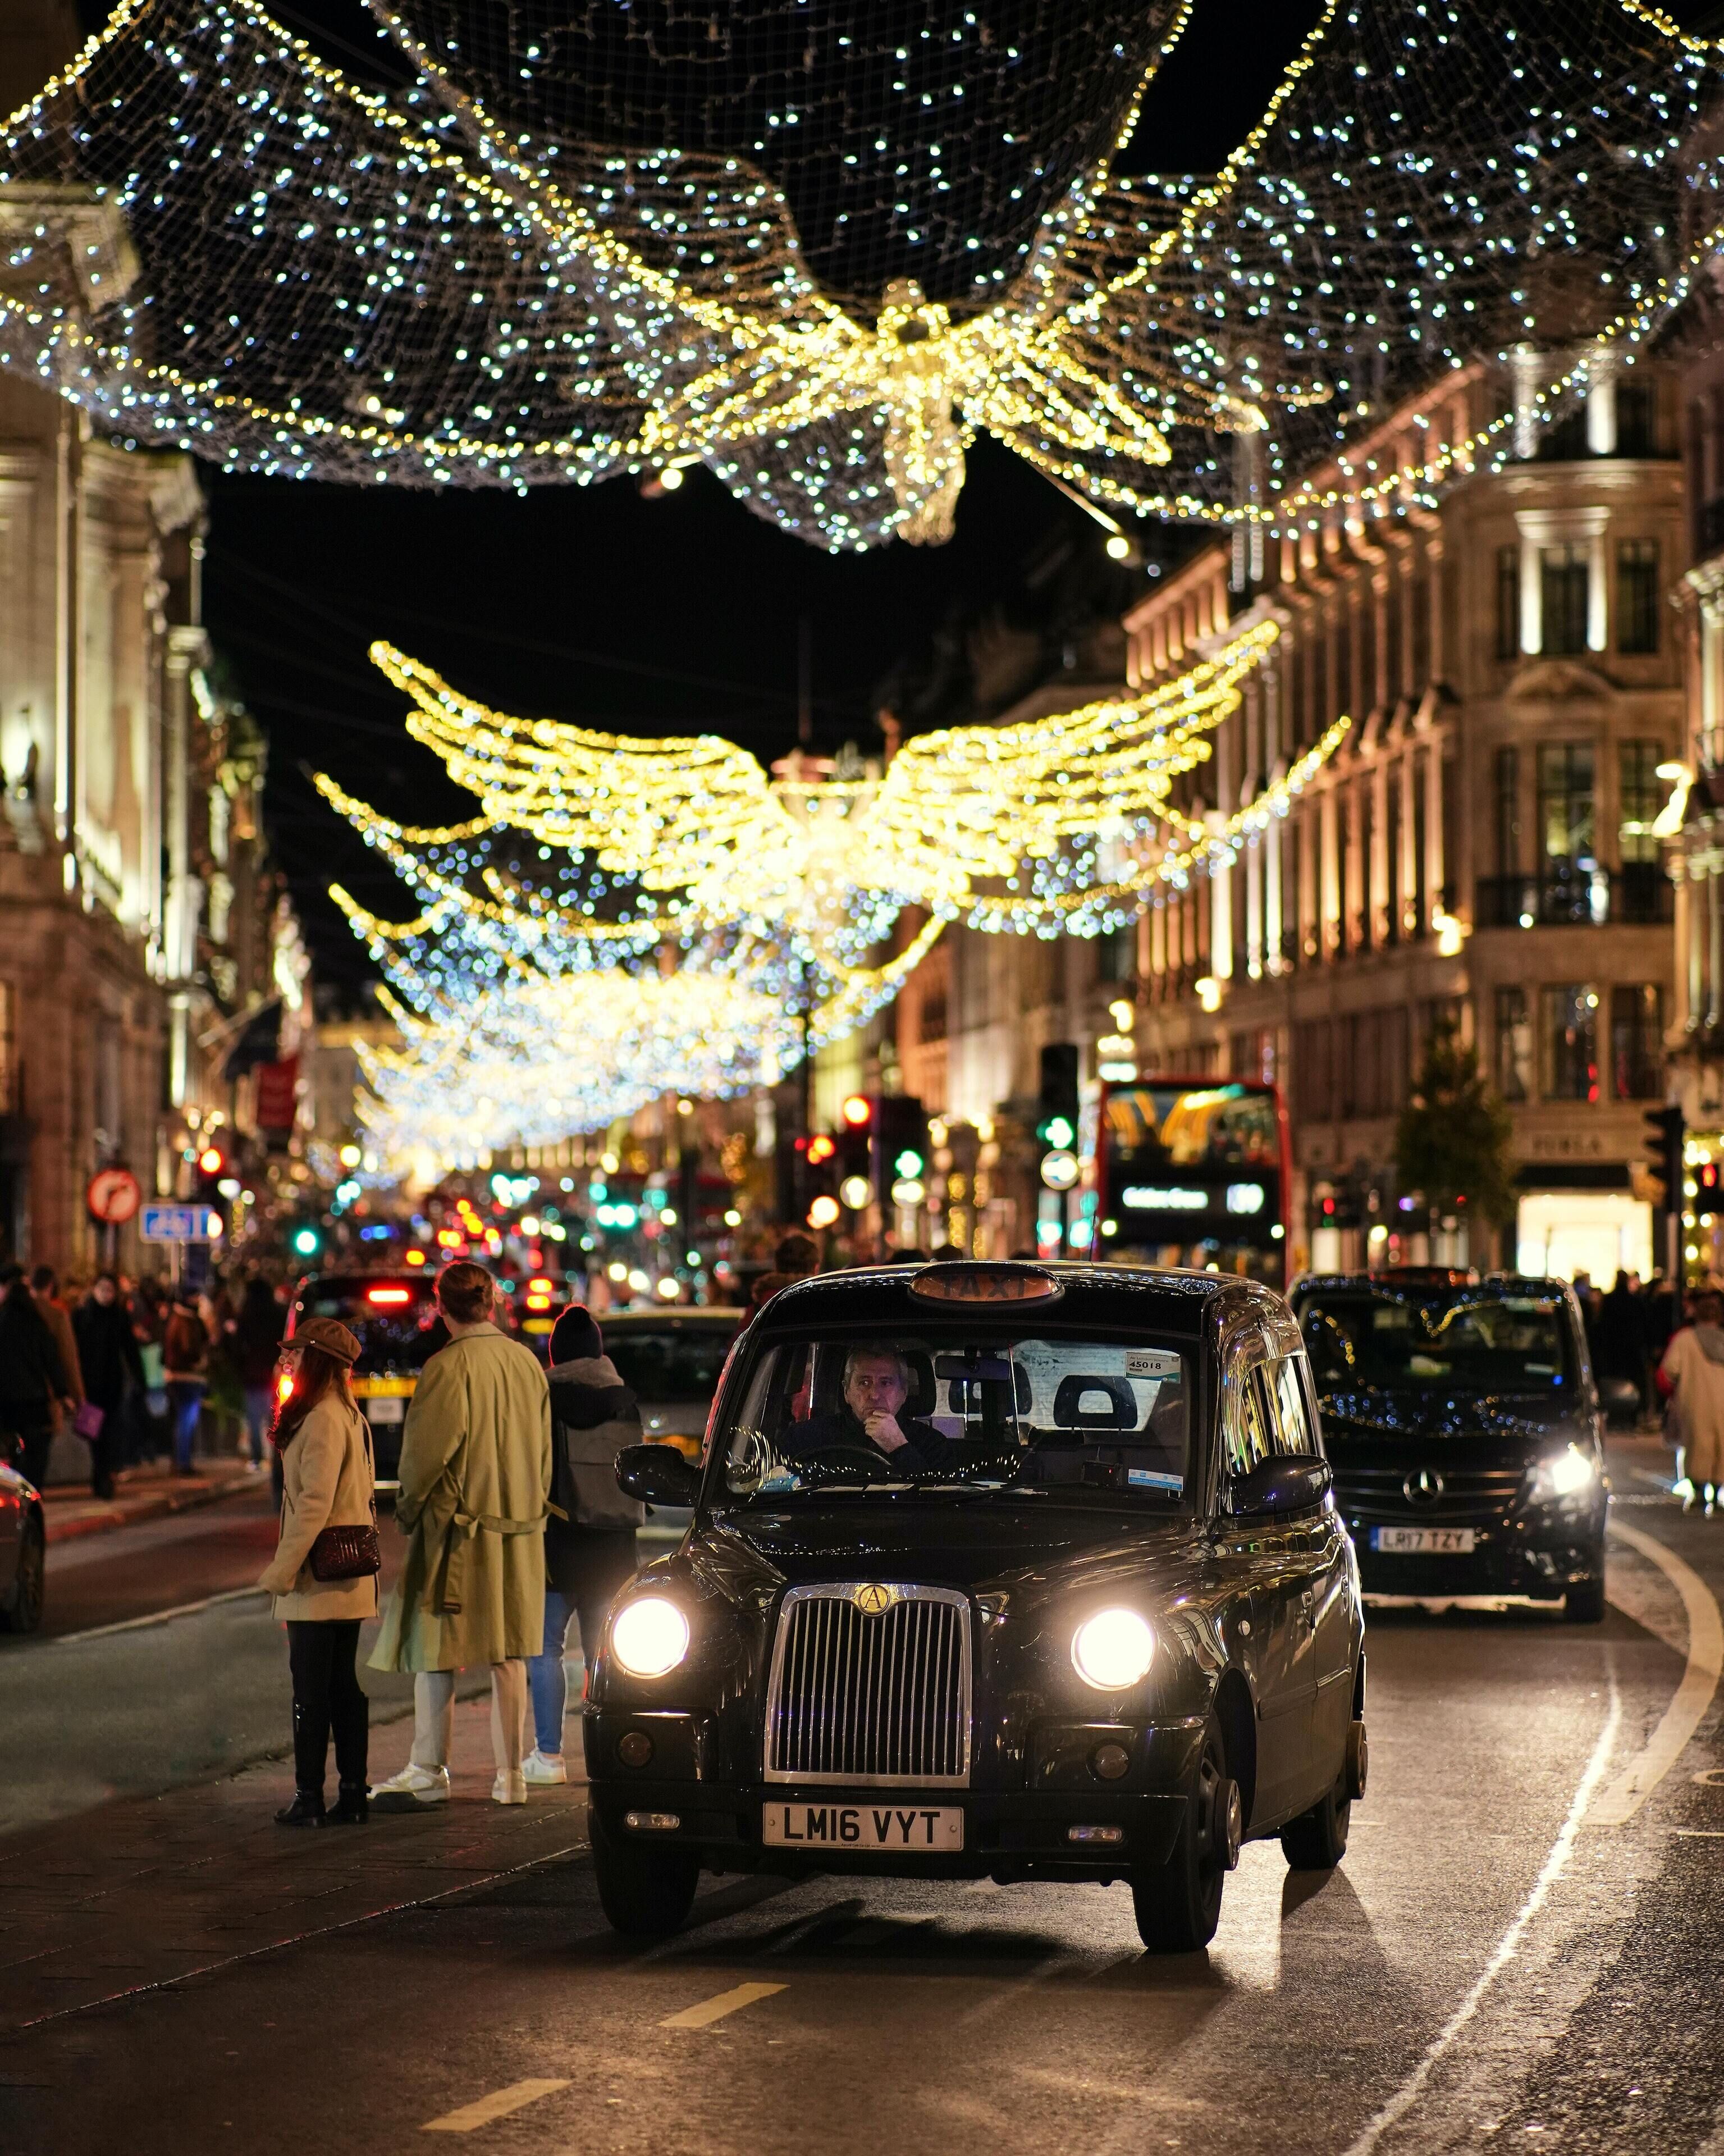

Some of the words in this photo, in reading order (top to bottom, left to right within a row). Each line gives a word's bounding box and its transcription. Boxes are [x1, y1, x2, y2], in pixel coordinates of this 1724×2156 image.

[941, 1274, 1025, 1298] TAXI
[1129, 1361, 1161, 1369] 45018
[863, 1586, 882, 1609] A
[784, 1807, 859, 1842] LM16
[872, 1810, 940, 1844] VYT
